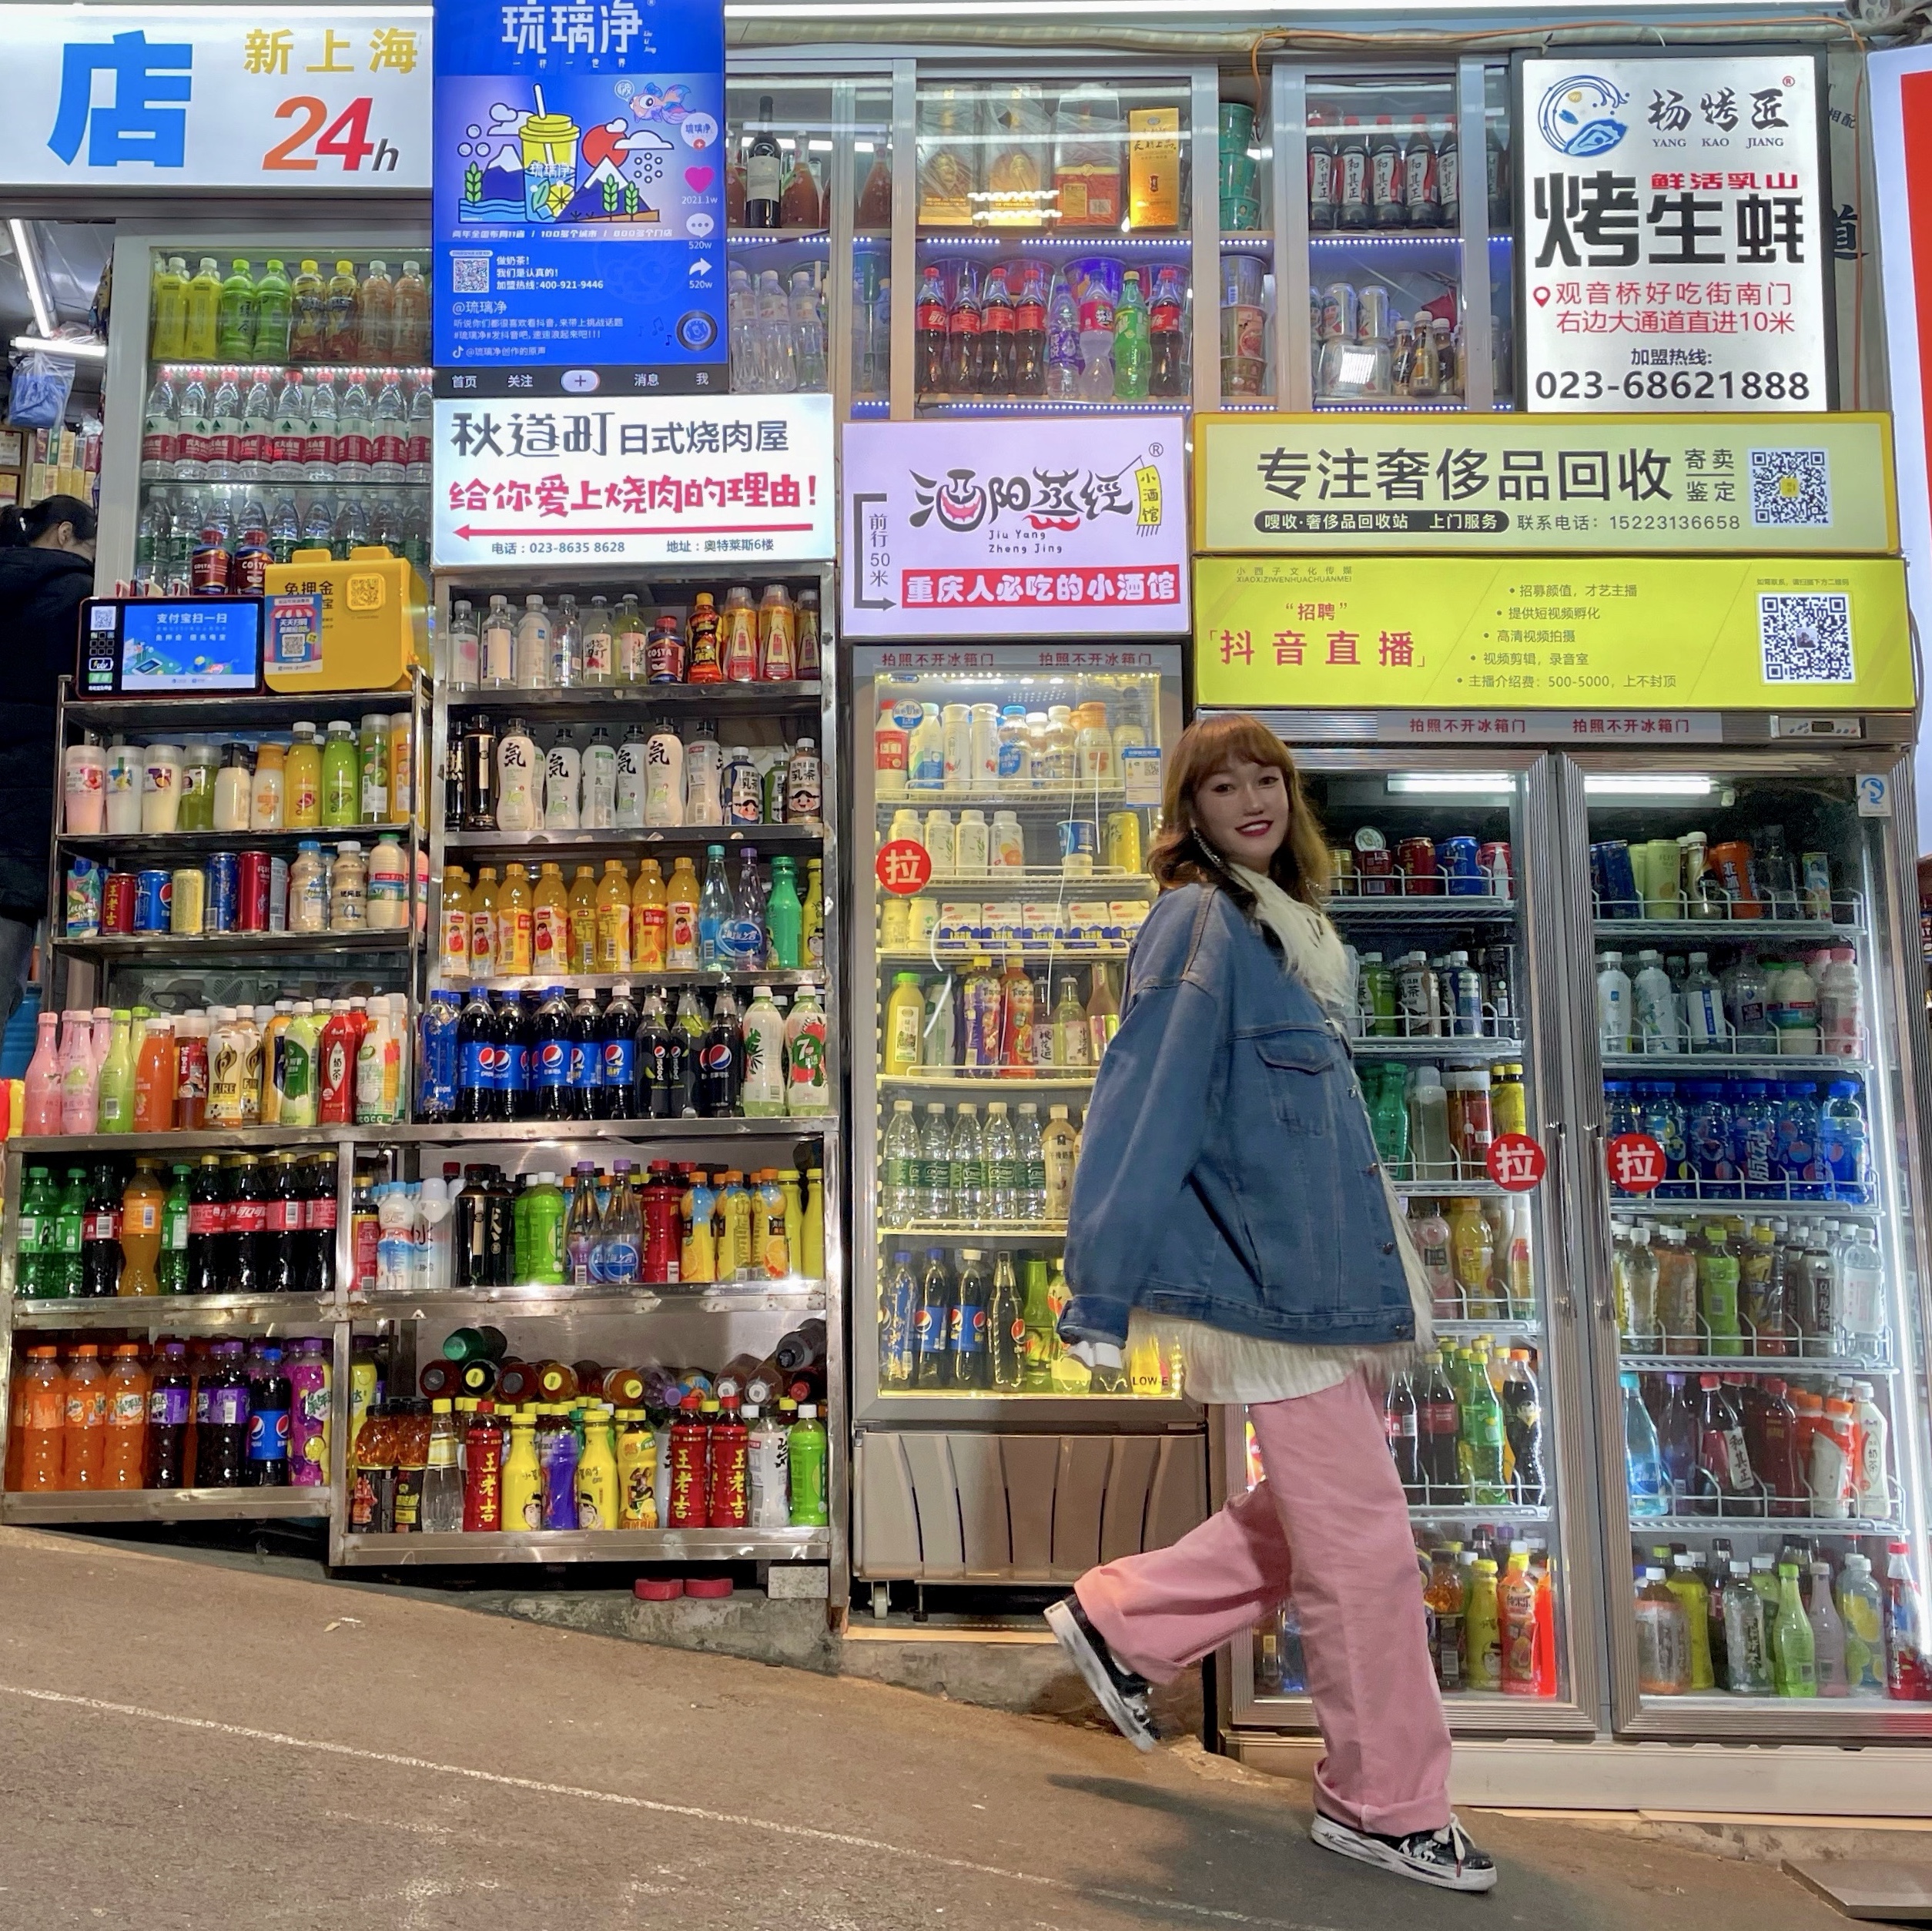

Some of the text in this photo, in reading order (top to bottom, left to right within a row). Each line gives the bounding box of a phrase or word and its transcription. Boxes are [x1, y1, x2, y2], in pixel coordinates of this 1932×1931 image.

[501, 0, 642, 54] 琉璃净
[243, 28, 418, 75] 新上海
[47, 30, 193, 167] 店
[262, 95, 400, 171] 24h
[1652, 137, 1784, 149] YANG KAO JIANG
[1650, 172, 1799, 190] 鲜活乳山
[681, 196, 718, 205] 2021.1w
[1533, 170, 1806, 269] 烤生蚝
[688, 240, 712, 250] 520w
[689, 279, 713, 289] 520w
[1555, 282, 1792, 306] 观音桥好吃街南门
[452, 300, 507, 315] @琉璃净
[1555, 310, 1796, 335] 右边大通道直进10米
[452, 375, 477, 389] 首页
[507, 374, 534, 388] 关注
[634, 373, 660, 387] 消息
[695, 372, 709, 386] 我
[1535, 370, 1810, 400] 023-68621888
[619, 420, 789, 456] 日式烧肉屋
[1684, 448, 1735, 470] 寄卖
[1256, 446, 1673, 502] 专注奢侈品回收
[1140, 472, 1160, 523] 小酒馆
[1686, 480, 1736, 503] 鉴定
[1428, 513, 1498, 530] 上门服务
[989, 529, 1046, 541] Jiu Yang
[594, 540, 625, 553] 8628
[989, 543, 1063, 554] Zheng Jing
[284, 580, 334, 596] 免押金
[906, 571, 1177, 603] 重庆人必吃的小酒馆
[1519, 584, 1638, 597] 招募颜值，才艺主播
[156, 612, 228, 624] 支付宝扫一扫
[1508, 607, 1601, 620] 提供短视频孵化
[1497, 630, 1576, 643] 高清视频拍摄
[648, 648, 673, 657] COSTA
[881, 652, 995, 667] 拍照不开冰箱门
[1038, 651, 1153, 666] 拍照不开冰箱门
[1483, 652, 1589, 666] 视频剪辑，录音室
[1409, 718, 1526, 734] 拍照不开冰箱门
[1572, 718, 1690, 734] 拍照不开冰箱门
[791, 769, 816, 782] 乳茶
[885, 848, 922, 885] 拉
[105, 885, 119, 927] 王老吉
[333, 1058, 343, 1081] 奶茶
[655, 1058, 664, 1081] pepsi
[213, 1083, 236, 1094] FIRE
[1495, 1143, 1539, 1183] 拉
[1616, 1143, 1658, 1184] 拉
[479, 1452, 497, 1522] 王老吉
[672, 1448, 693, 1520] 王老吉
[729, 1448, 746, 1520] 王老吉
